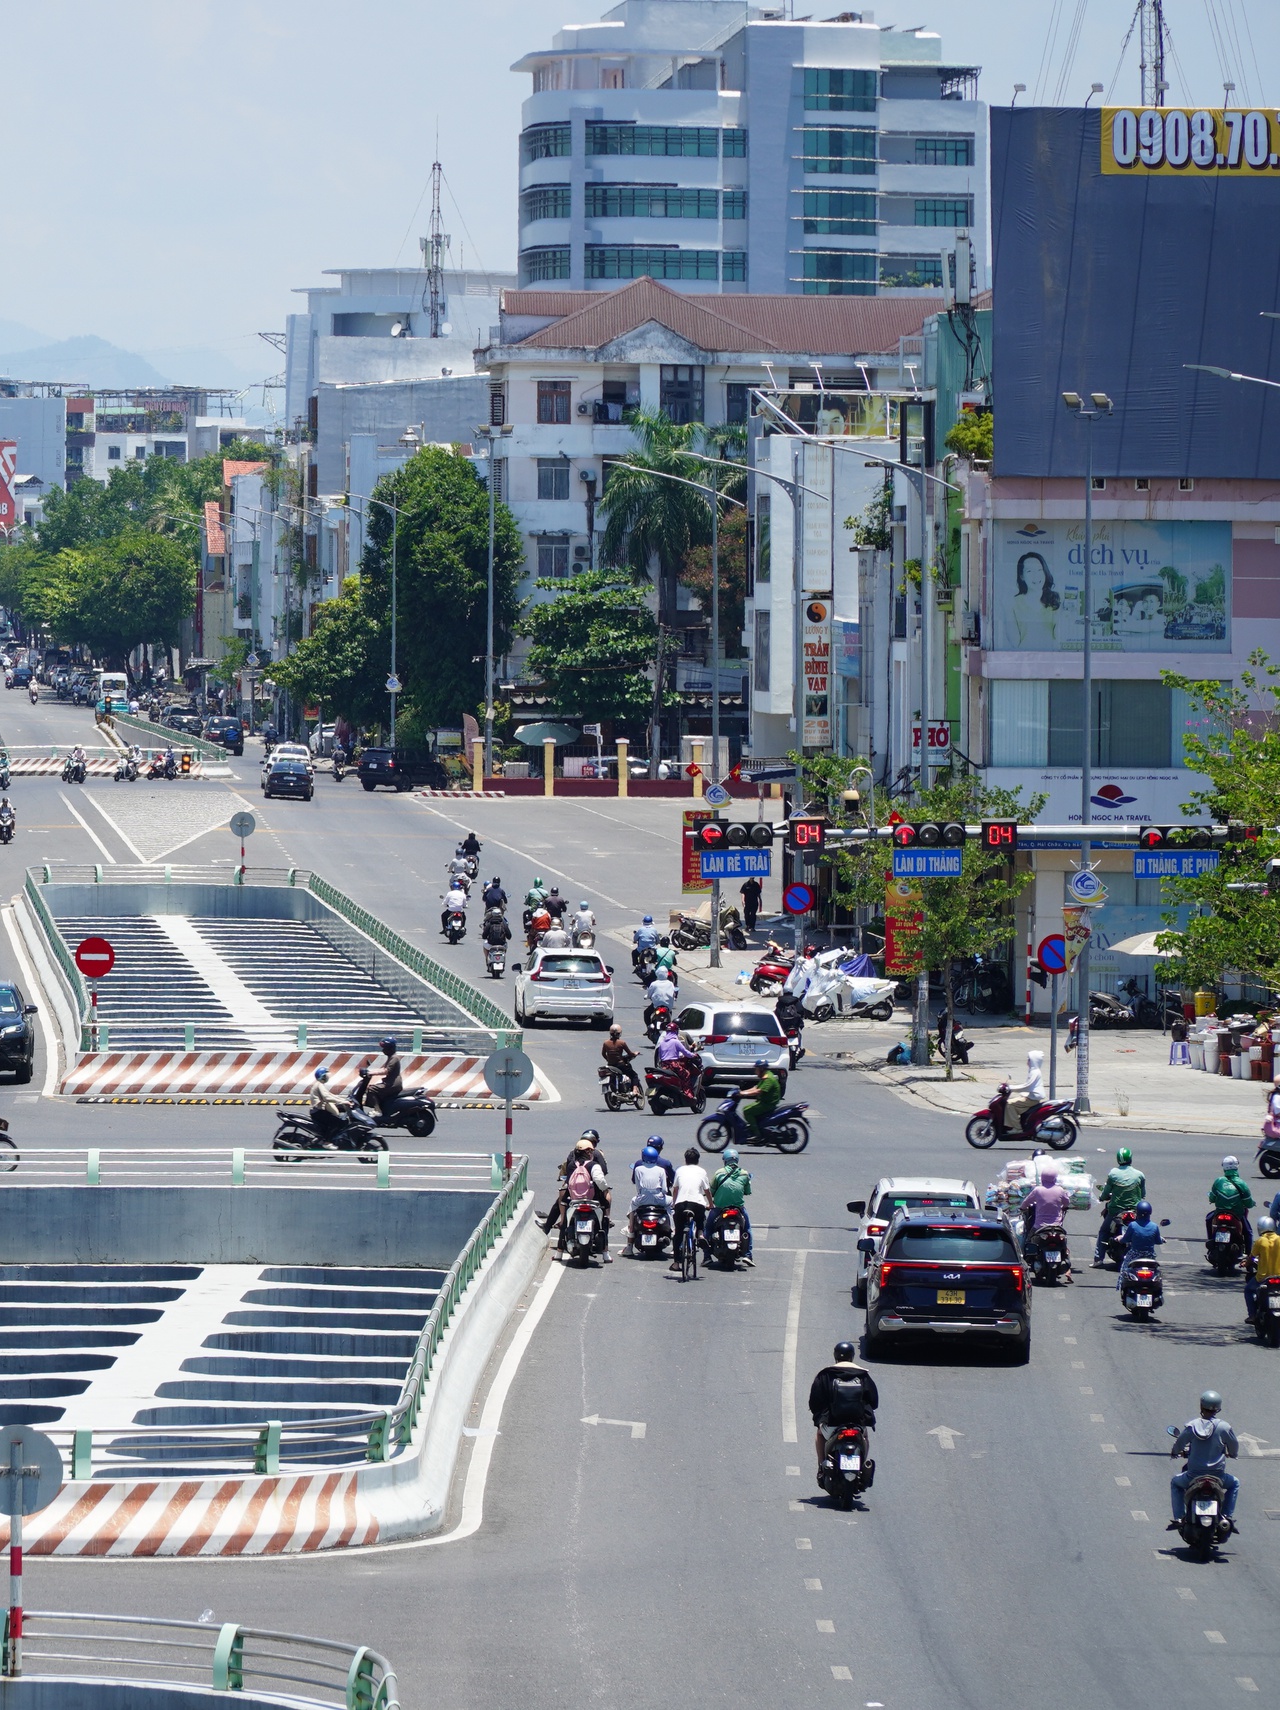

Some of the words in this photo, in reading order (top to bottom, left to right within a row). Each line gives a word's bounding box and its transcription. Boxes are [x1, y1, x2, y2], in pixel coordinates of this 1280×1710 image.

[1113, 110, 1280, 168] 0908.70.
[1120, 549, 1150, 570] vụ
[804, 657, 829, 675] ĐÌNH
[806, 676, 827, 694] VẠN
[796, 823, 820, 845] 04
[988, 824, 1013, 845] 04
[702, 853, 724, 873] LÀN
[726, 853, 741, 872] RẼ
[895, 854, 914, 872] LÀN
[916, 857, 927, 872] ĐI
[928, 850, 960, 872] THẲNG
[1136, 858, 1145, 874] ĐI
[1182, 855, 1193, 874] RẼ
